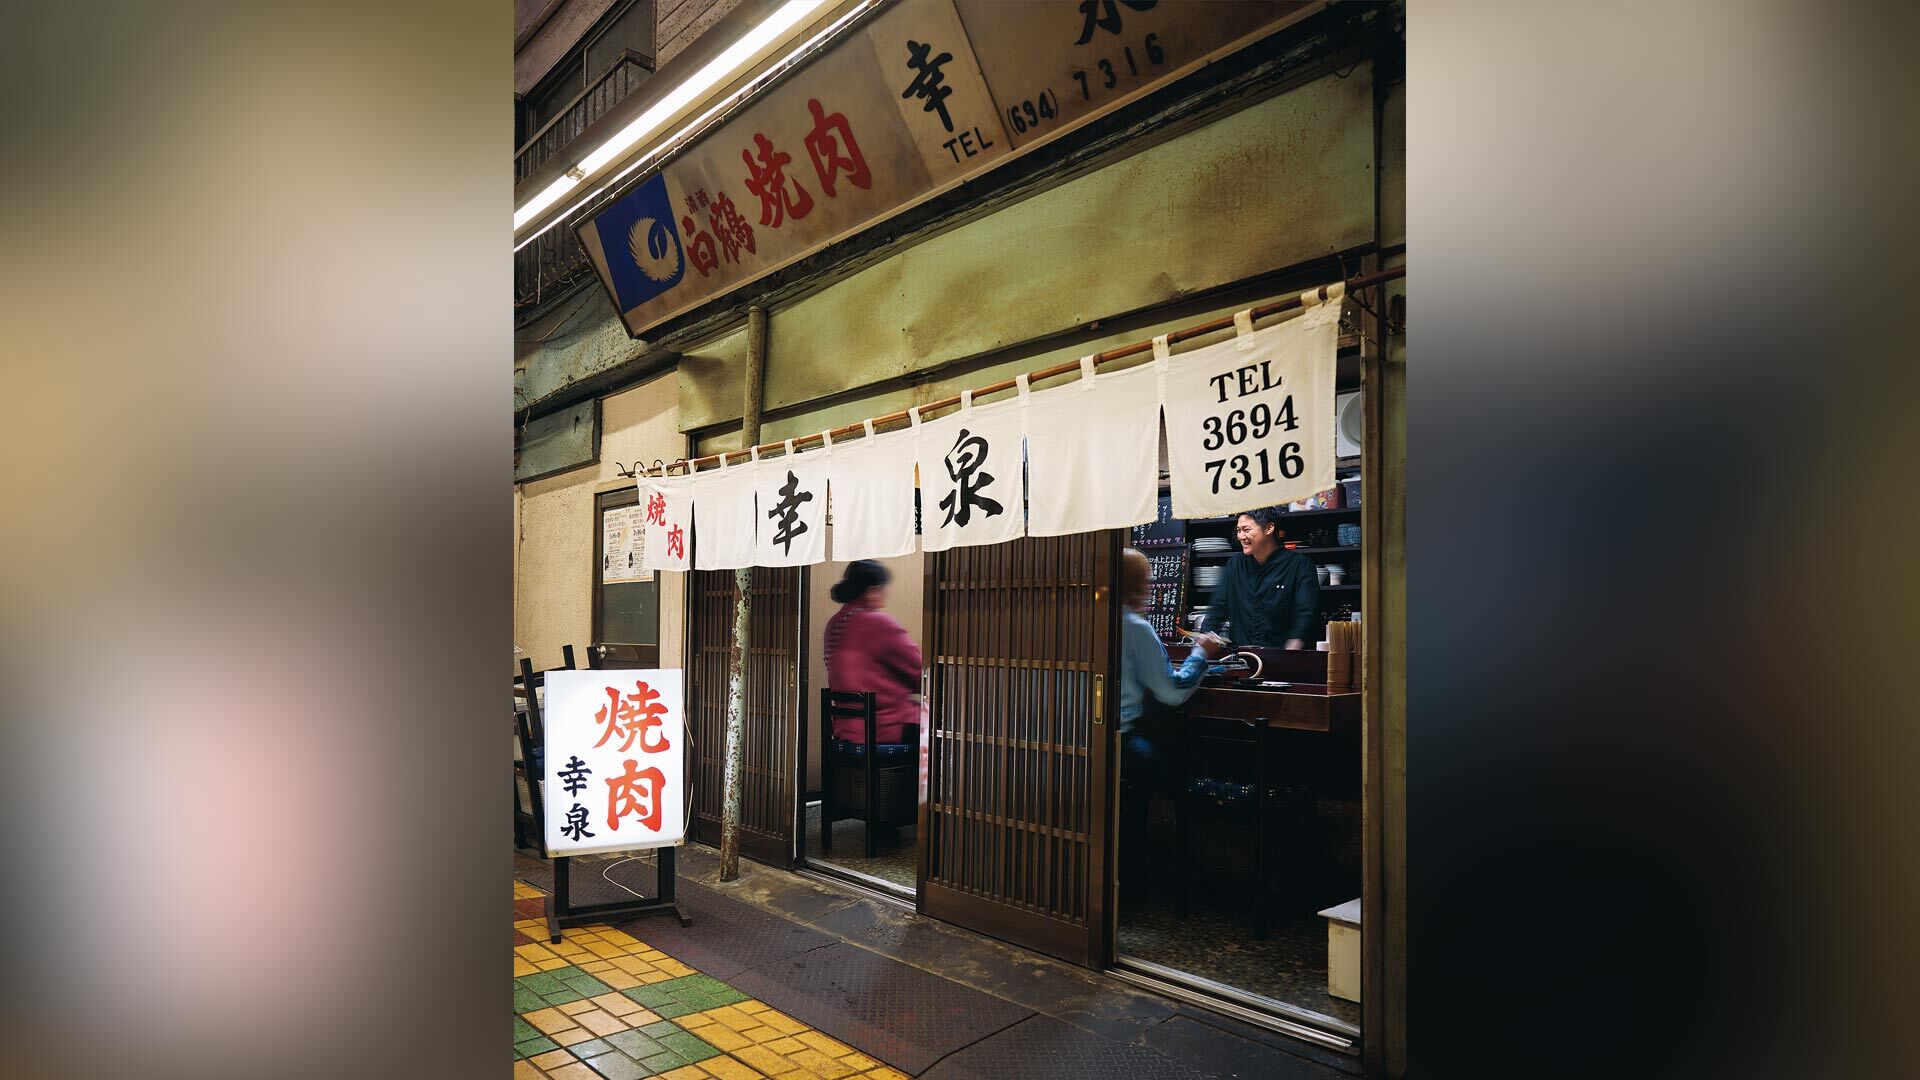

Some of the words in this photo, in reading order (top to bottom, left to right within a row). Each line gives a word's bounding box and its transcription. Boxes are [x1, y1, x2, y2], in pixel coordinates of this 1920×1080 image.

[902, 40, 953, 132] 幸
[943, 127, 993, 163] TEL
[1007, 88, 1059, 137] (694)
[1073, 32, 1164, 101] 7316
[742, 99, 871, 228] 焼肉
[1203, 395, 1299, 451] 3694
[1210, 361, 1282, 403] TEL
[1204, 442, 1304, 494] 7316
[645, 491, 684, 560] 焼肉
[557, 756, 596, 842] 幸泉
[594, 680, 671, 832] 焼肉
